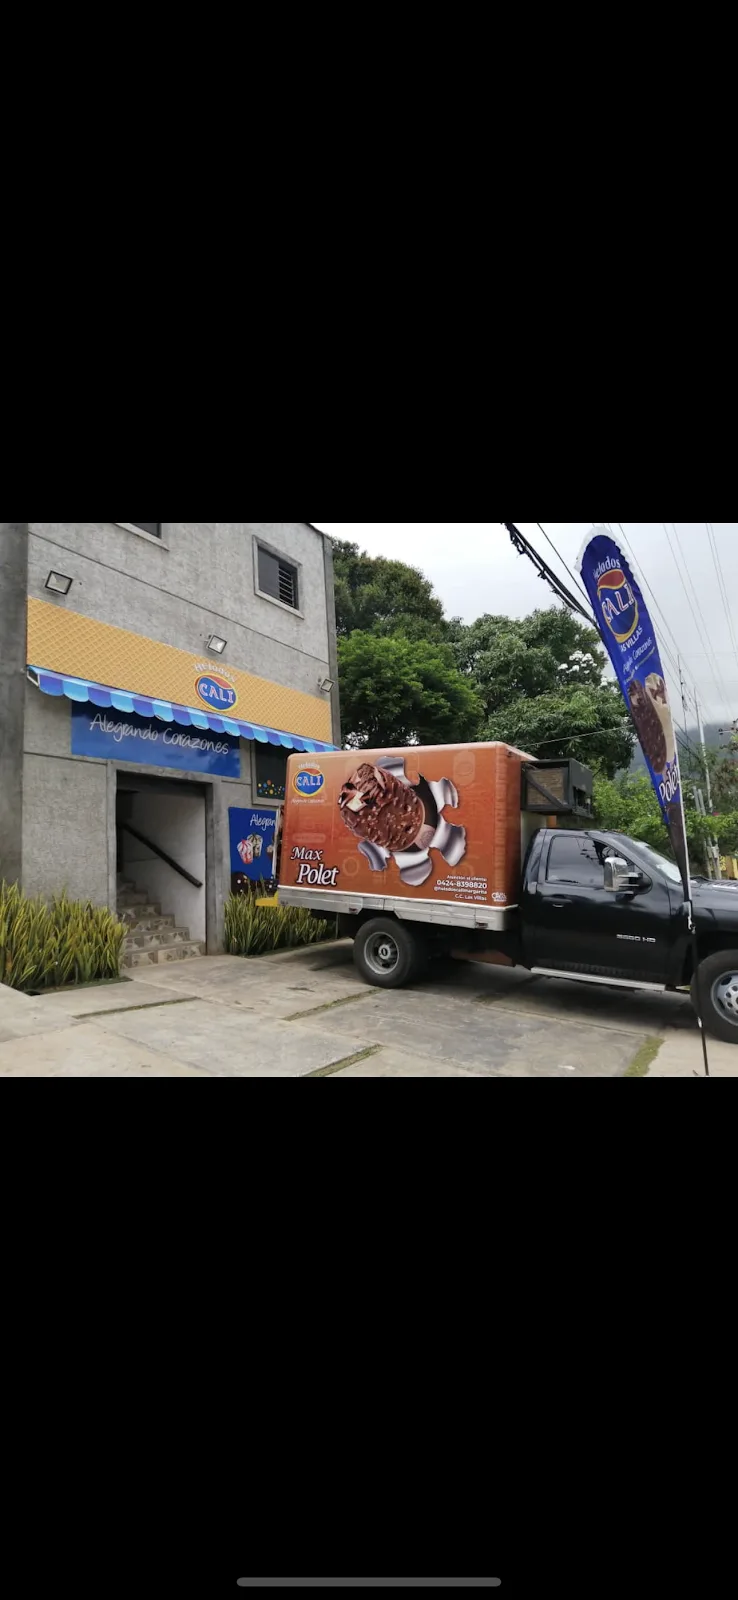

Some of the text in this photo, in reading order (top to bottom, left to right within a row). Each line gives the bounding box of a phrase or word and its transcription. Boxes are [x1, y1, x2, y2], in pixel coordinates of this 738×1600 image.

[602, 584, 635, 623] CALI
[199, 682, 234, 704] CALI
[89, 713, 229, 755] Alegrando Corazones
[296, 775, 322, 787] CALI
[290, 846, 323, 861] Max
[296, 863, 339, 886] Polet
[436, 879, 487, 888] 0424-8398820
